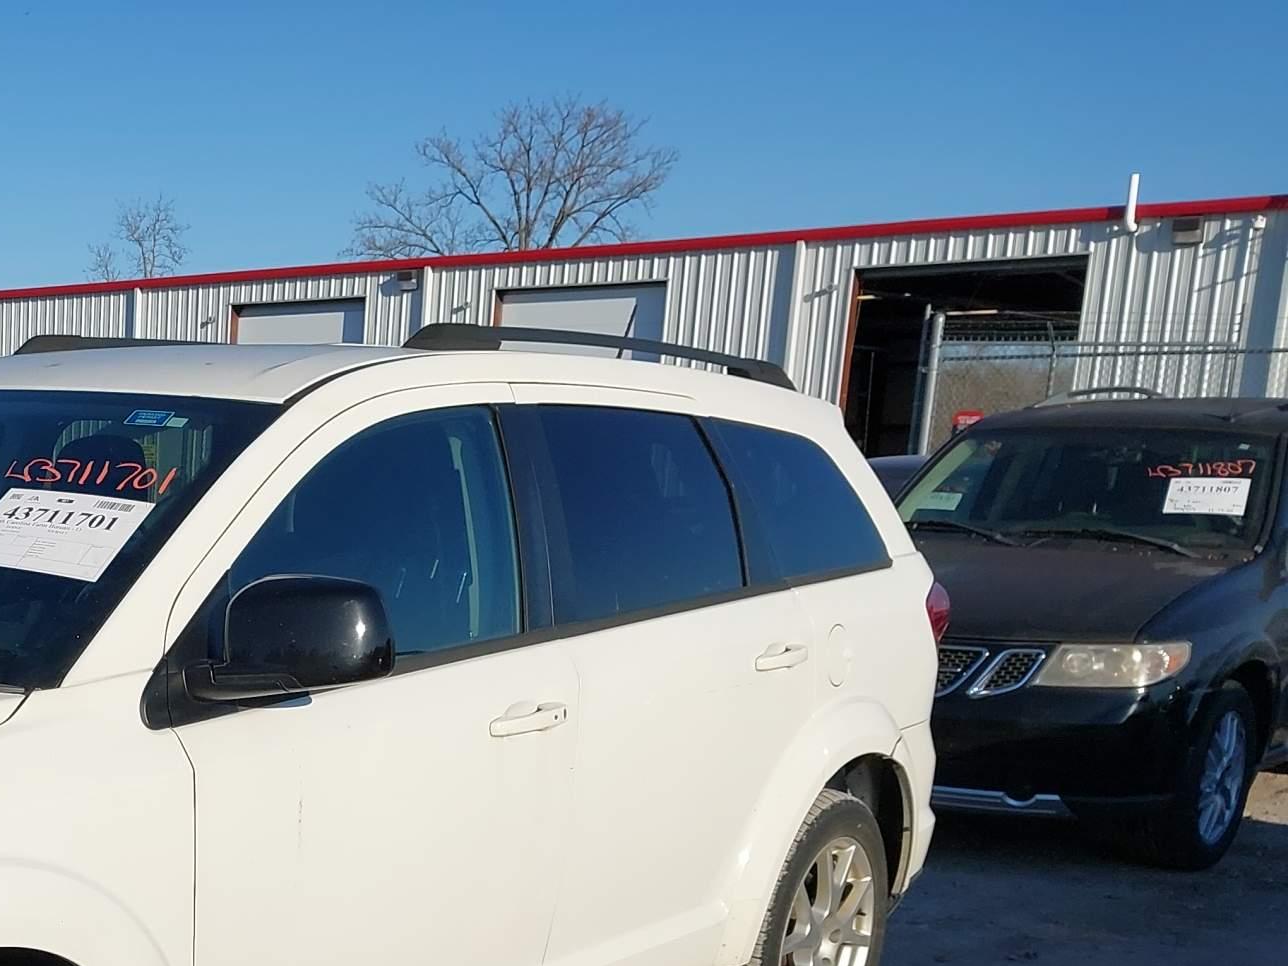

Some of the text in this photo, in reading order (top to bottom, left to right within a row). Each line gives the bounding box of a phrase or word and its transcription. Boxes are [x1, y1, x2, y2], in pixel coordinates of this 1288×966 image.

[4, 458, 178, 495] 43711701
[1148, 459, 1256, 478] 43711807
[2, 505, 119, 532] 43711701
